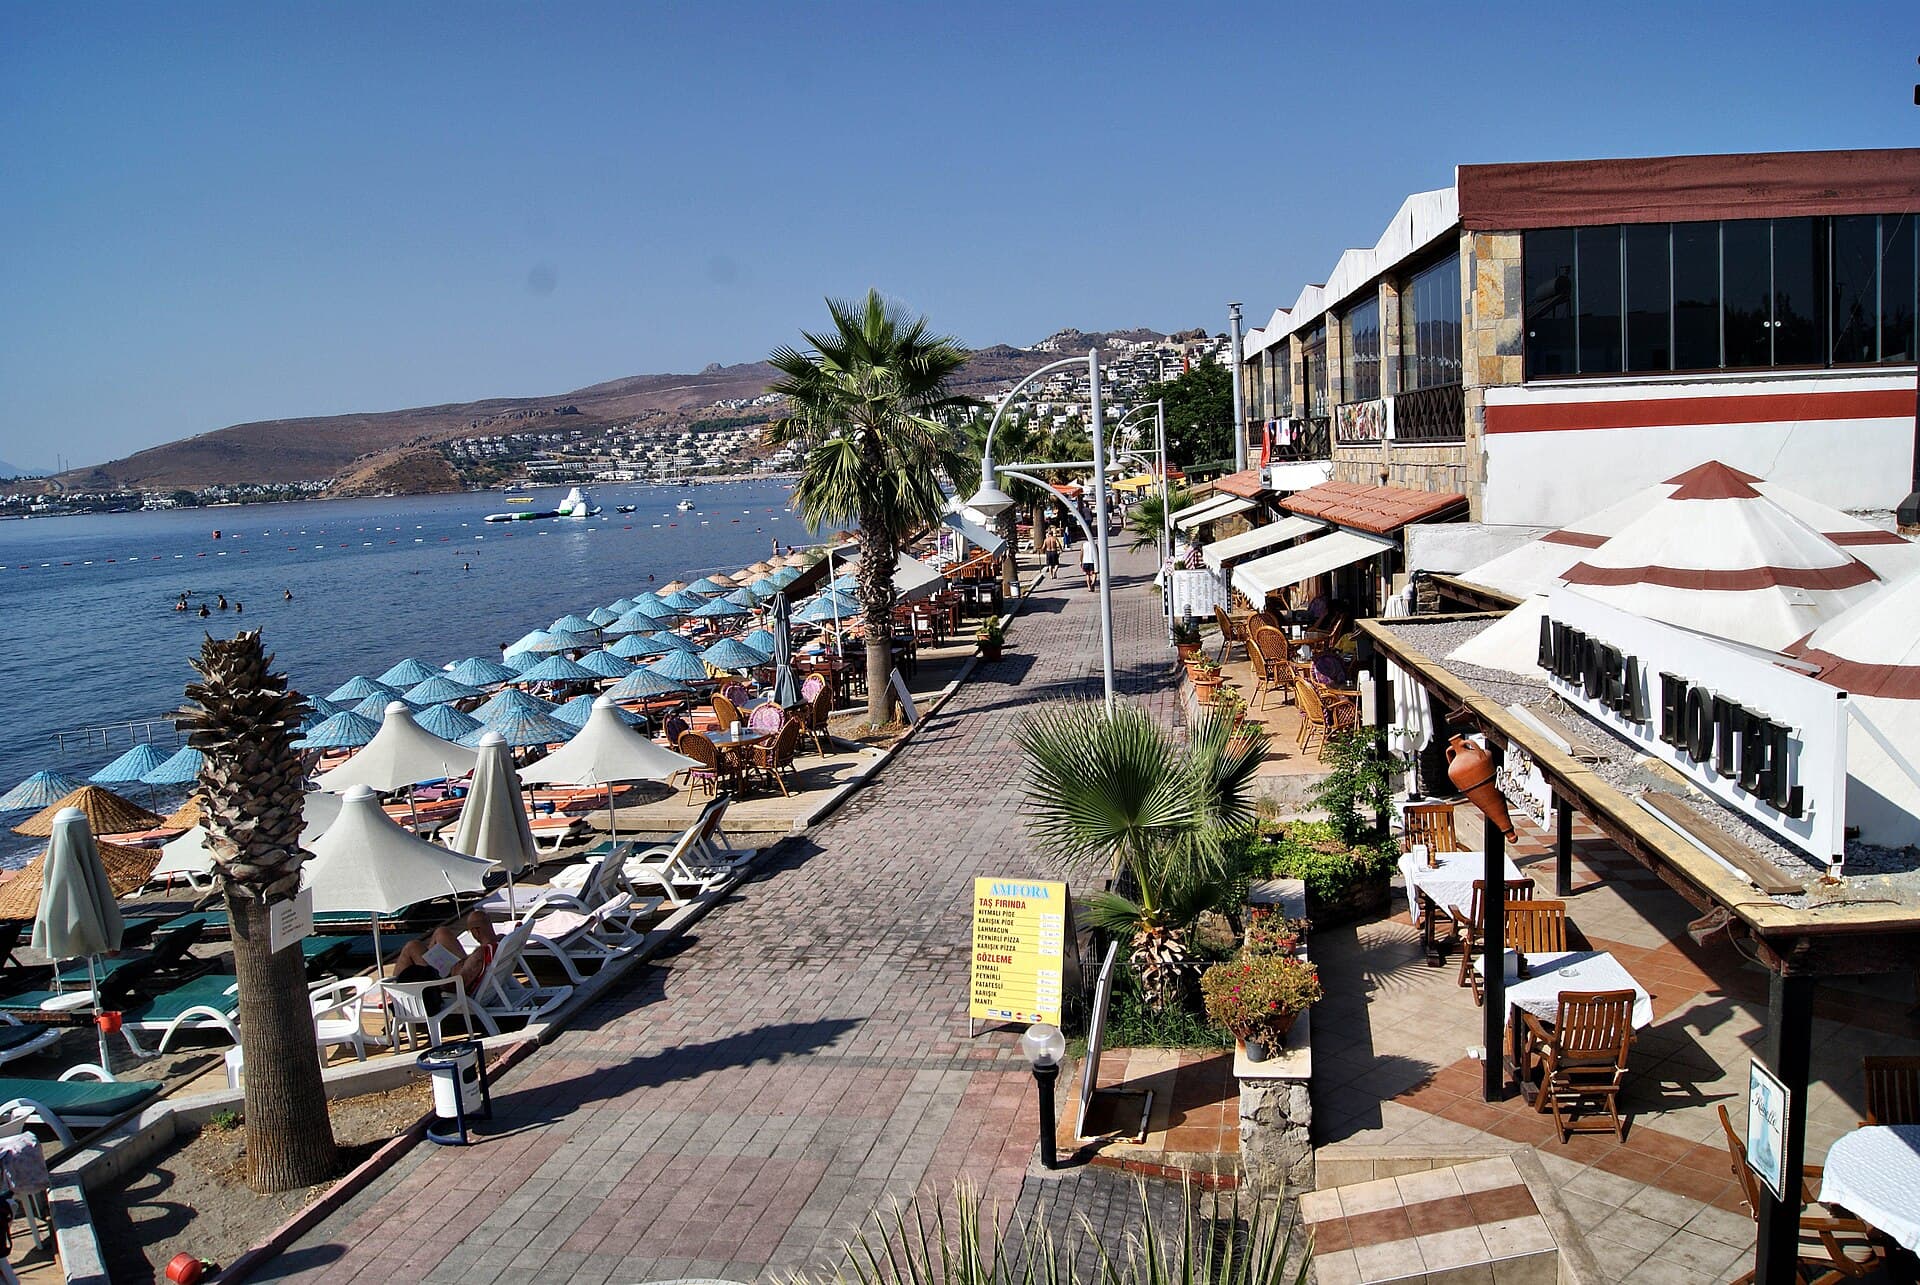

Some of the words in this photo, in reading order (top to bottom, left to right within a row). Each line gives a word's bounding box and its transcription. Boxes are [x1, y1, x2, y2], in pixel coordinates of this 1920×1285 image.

[1659, 672, 1804, 818] HOTEL
[991, 883, 1050, 899] AMFORA
[979, 897, 993, 909] TAŞ
[995, 899, 1026, 909] FIRINDA
[977, 926, 1009, 934] LAHMACUN
[976, 952, 1013, 964] GÖZLEME
